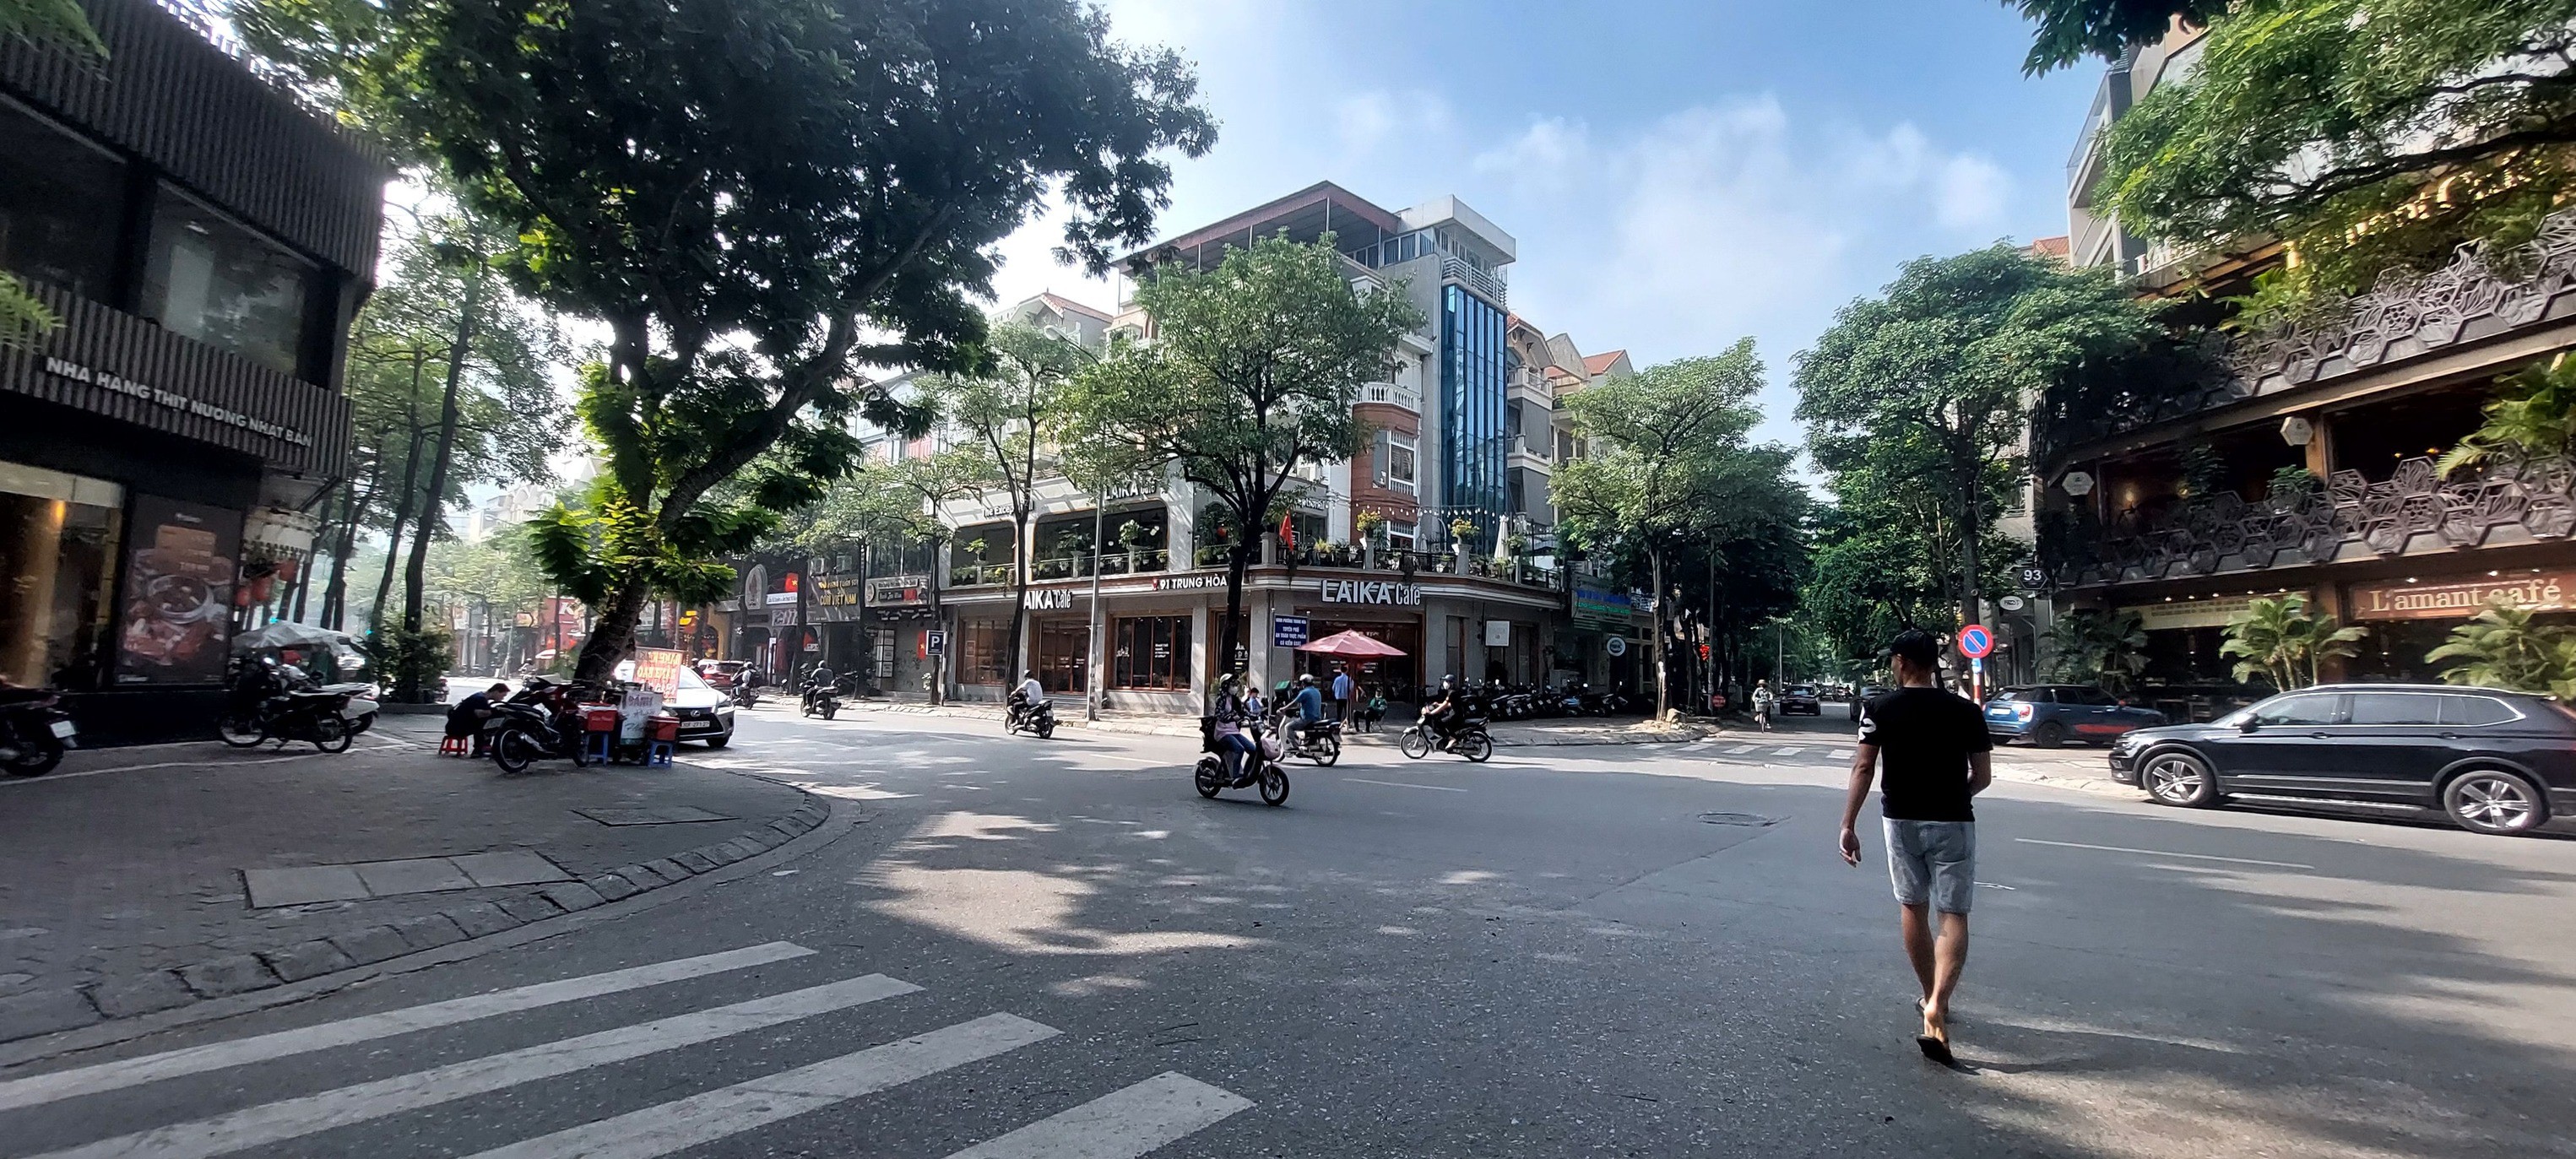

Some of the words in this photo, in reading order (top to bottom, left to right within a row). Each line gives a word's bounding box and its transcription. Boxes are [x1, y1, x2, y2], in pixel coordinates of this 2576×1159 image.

[1159, 579, 1170, 590] 91
[1172, 577, 1203, 589] TRUNG
[1205, 573, 1228, 588] HÒA
[2024, 569, 2042, 581] 93
[1022, 590, 1055, 609] AIKA
[1321, 579, 1391, 604] LAIKA
[1396, 582, 1421, 605] Café
[2369, 588, 2485, 612] L'amant
[2488, 577, 2562, 605] café
[930, 636, 941, 648] P
